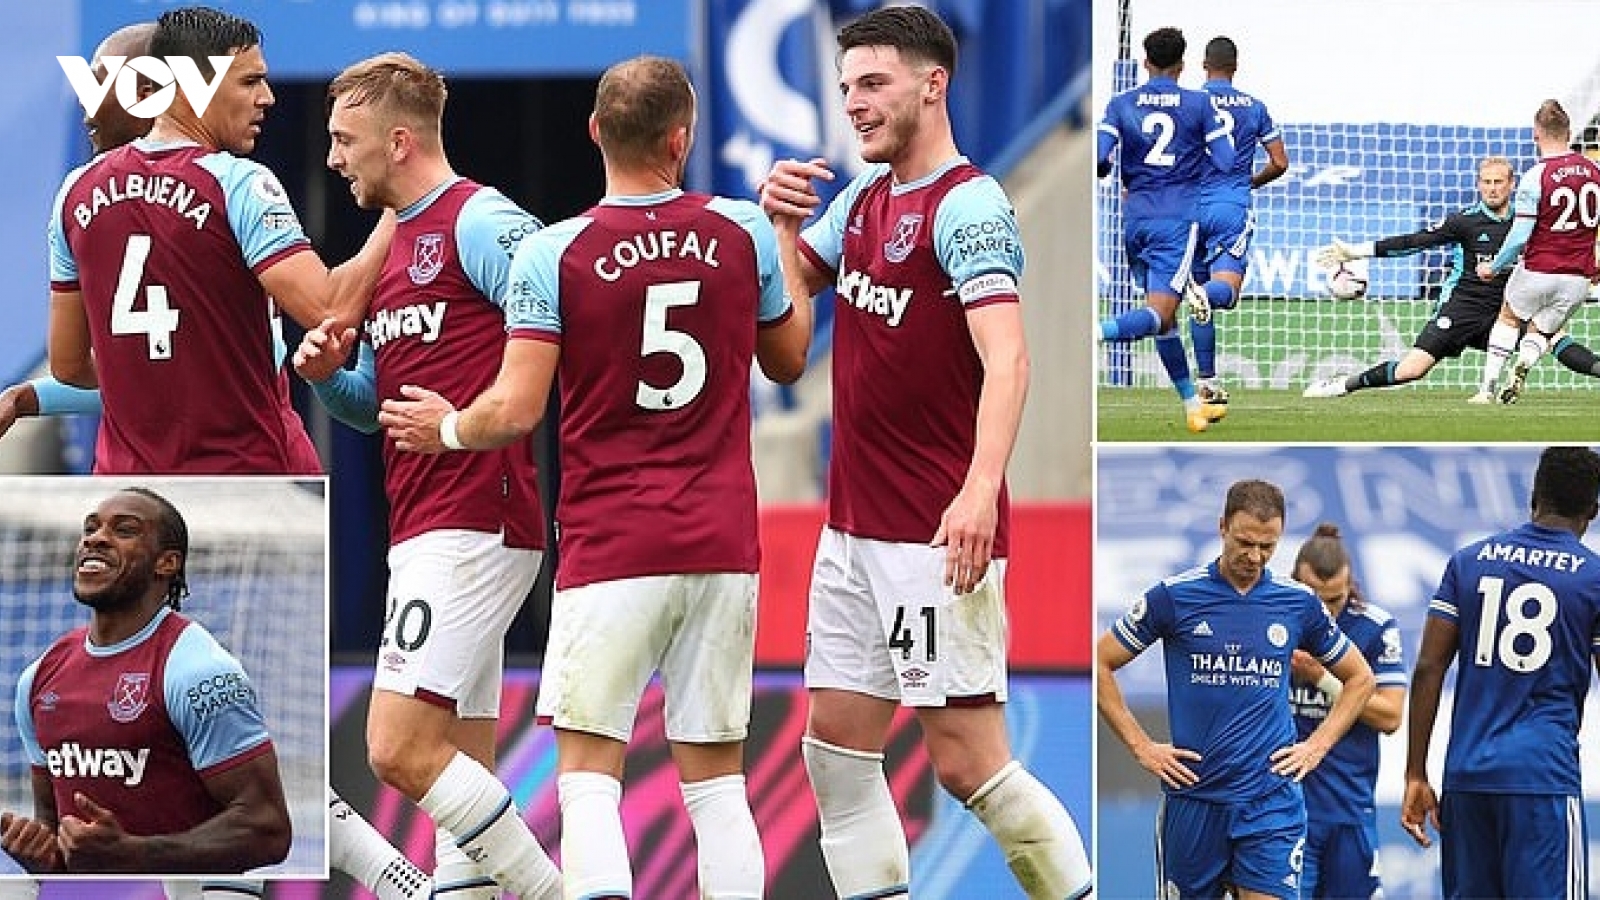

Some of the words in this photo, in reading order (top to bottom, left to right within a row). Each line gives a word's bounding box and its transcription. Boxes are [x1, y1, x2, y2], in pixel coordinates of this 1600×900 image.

[1142, 111, 1176, 166] 2
[73, 174, 211, 230] BALBUENA
[1550, 182, 1600, 233] 20
[594, 231, 720, 282] COUFAL
[111, 234, 180, 361] 4
[635, 280, 707, 411] 5
[1477, 543, 1586, 573] AMARTEY
[889, 605, 935, 662] 41
[1474, 575, 1558, 674] 18
[1191, 653, 1283, 677] THAILAND
[47, 741, 151, 786] etway
